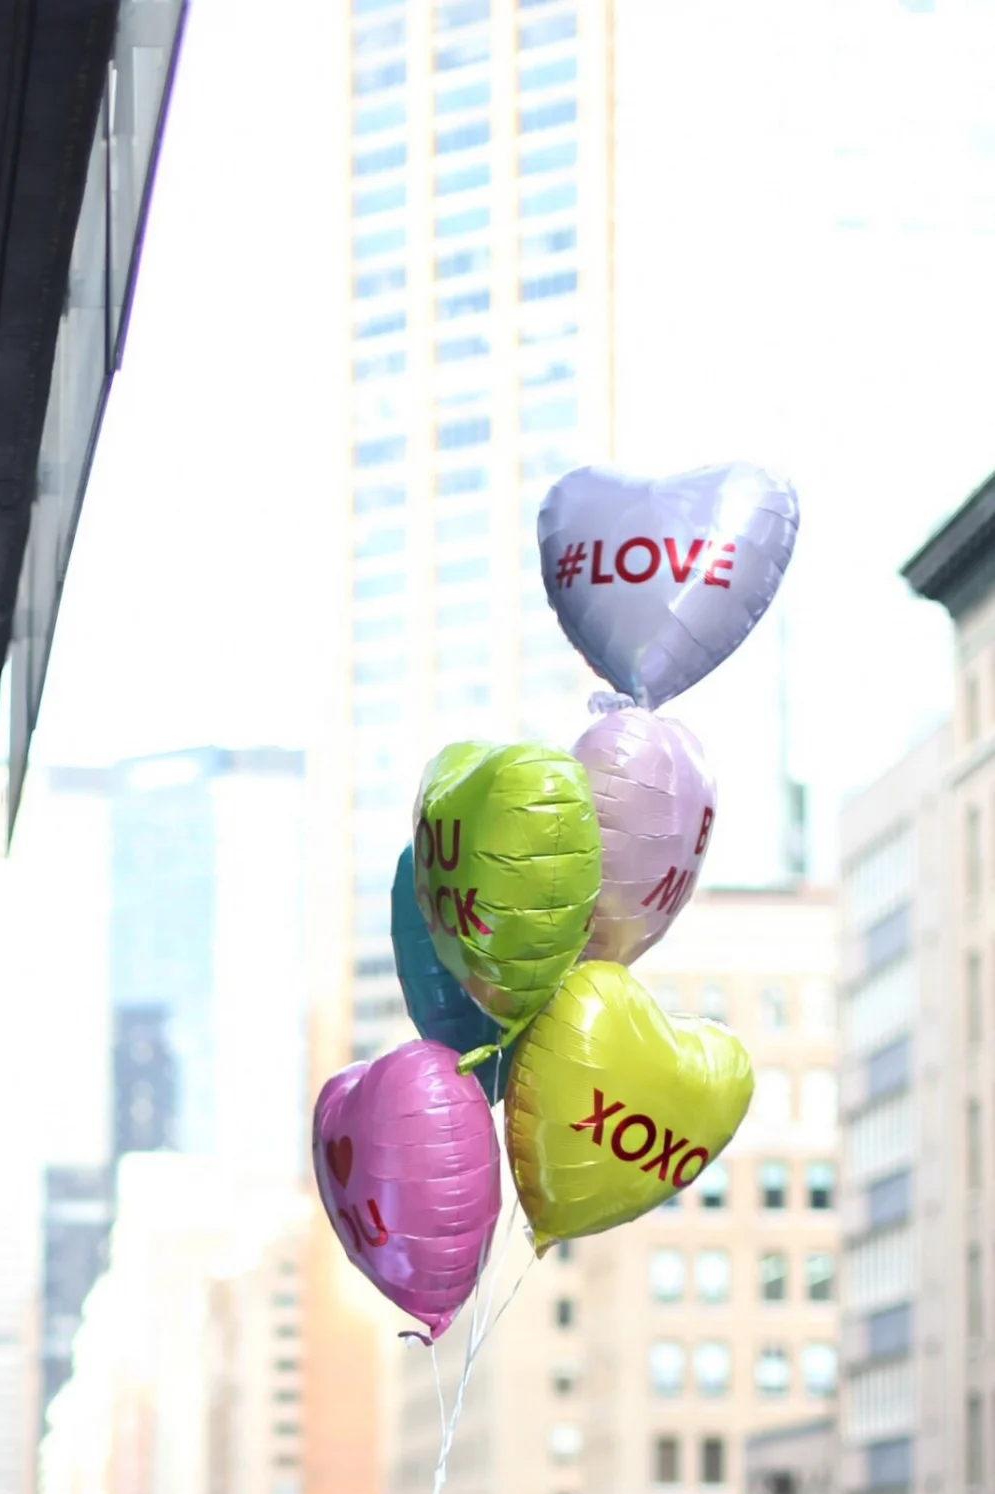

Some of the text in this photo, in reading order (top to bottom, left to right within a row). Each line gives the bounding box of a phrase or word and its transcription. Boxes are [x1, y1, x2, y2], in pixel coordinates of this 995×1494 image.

[556, 536, 736, 589] #LOVE
[415, 817, 461, 871] OU
[416, 884, 494, 937] OCK
[569, 1087, 709, 1189] XOXO
